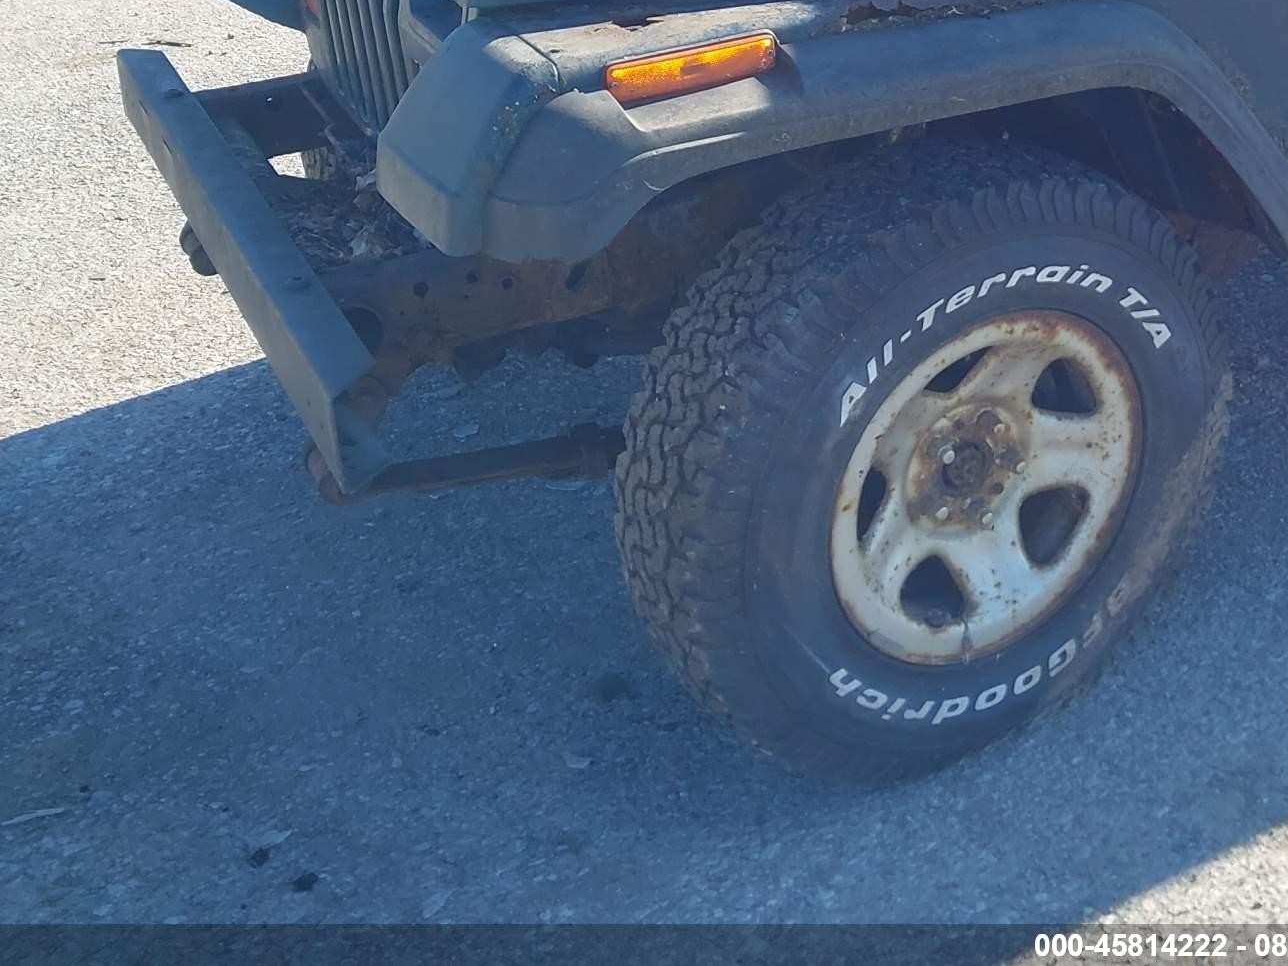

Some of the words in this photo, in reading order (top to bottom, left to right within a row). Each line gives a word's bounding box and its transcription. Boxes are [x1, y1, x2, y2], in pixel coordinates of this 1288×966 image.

[840, 264, 1113, 427] All-Terrain
[1119, 287, 1172, 349] T/A
[829, 577, 1129, 724] BFGoodrich
